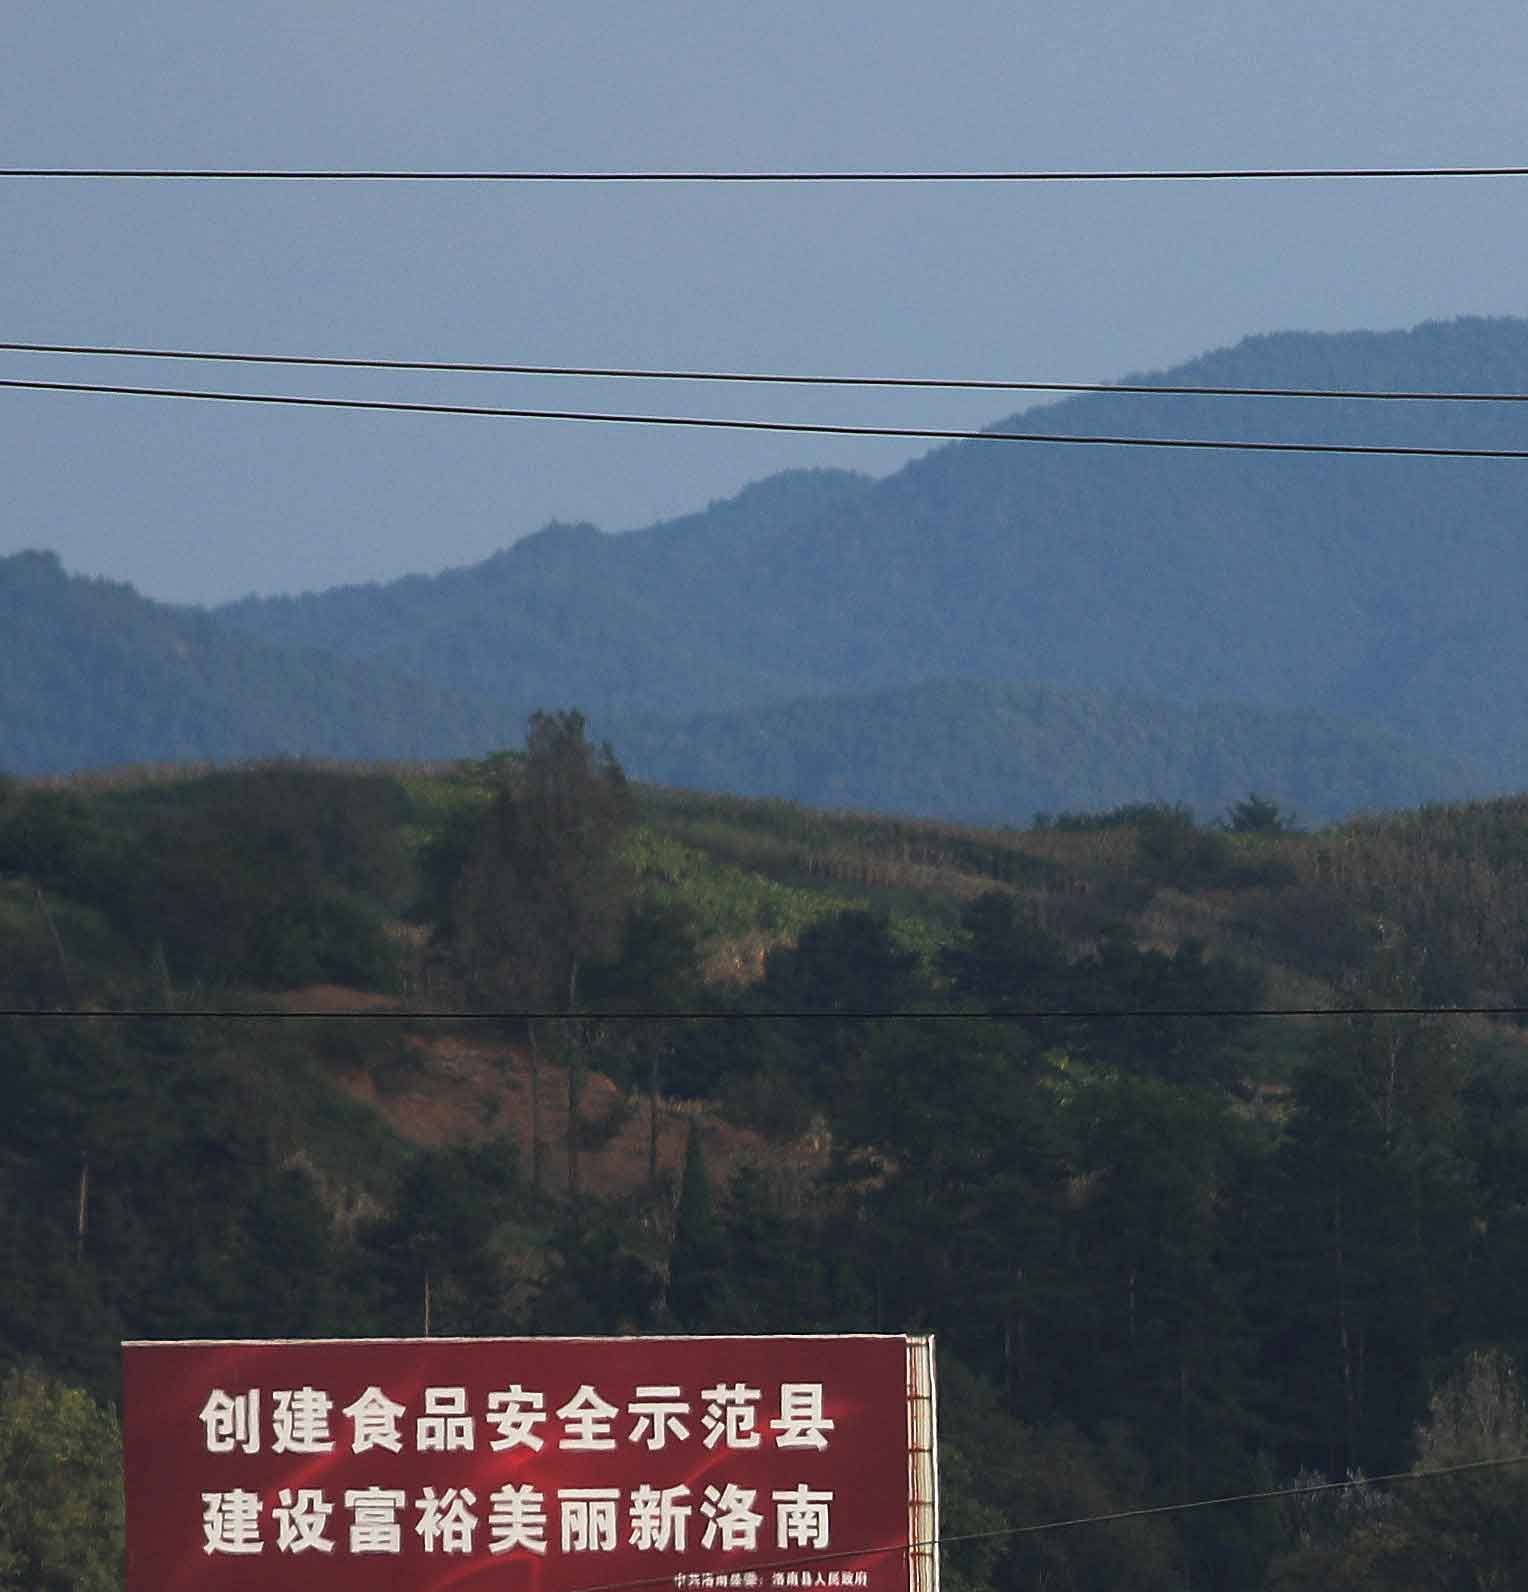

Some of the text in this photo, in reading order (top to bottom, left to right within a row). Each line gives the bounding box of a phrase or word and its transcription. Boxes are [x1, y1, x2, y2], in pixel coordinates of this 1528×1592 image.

[199, 1383, 834, 1454] 创建食品安全示范县
[200, 1484, 834, 1556] 建设富裕美丽新洛南
